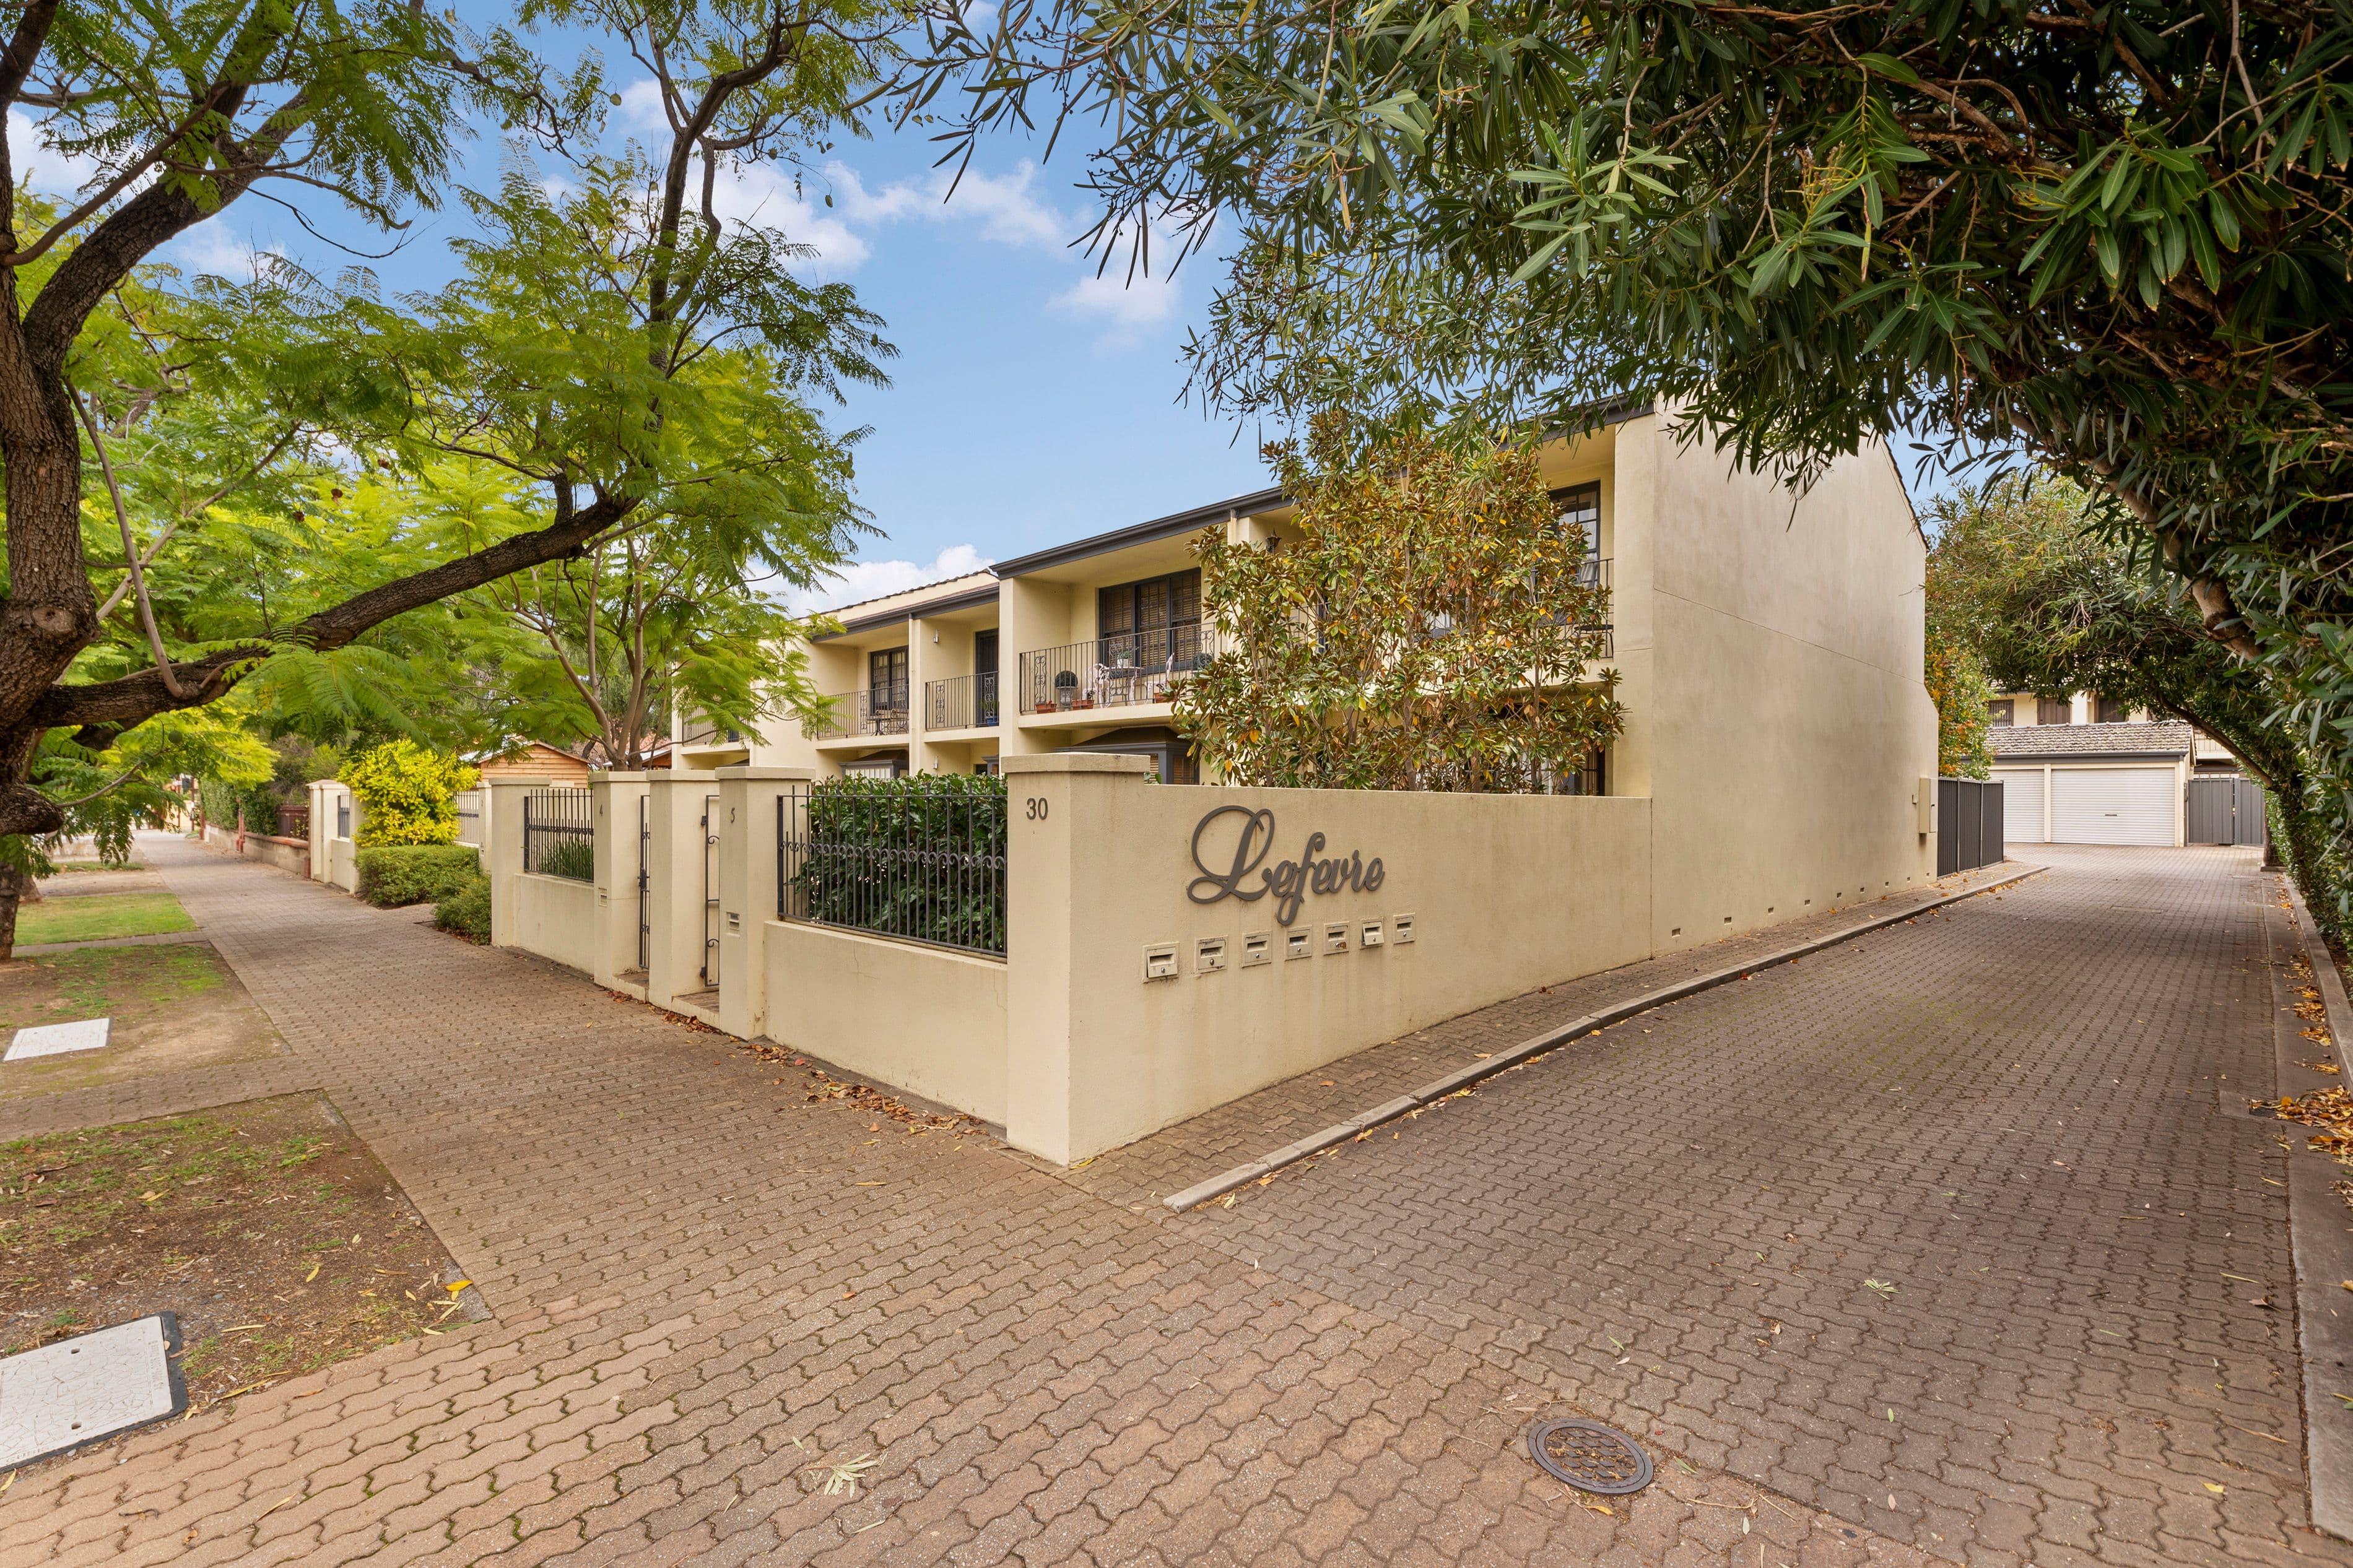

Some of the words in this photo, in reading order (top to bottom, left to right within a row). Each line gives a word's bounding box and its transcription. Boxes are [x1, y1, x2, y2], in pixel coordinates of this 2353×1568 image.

[599, 804, 604, 817] 4
[731, 807, 736, 824] 5
[1026, 797, 1048, 820] 30
[1187, 805, 1385, 926] Lefevre
